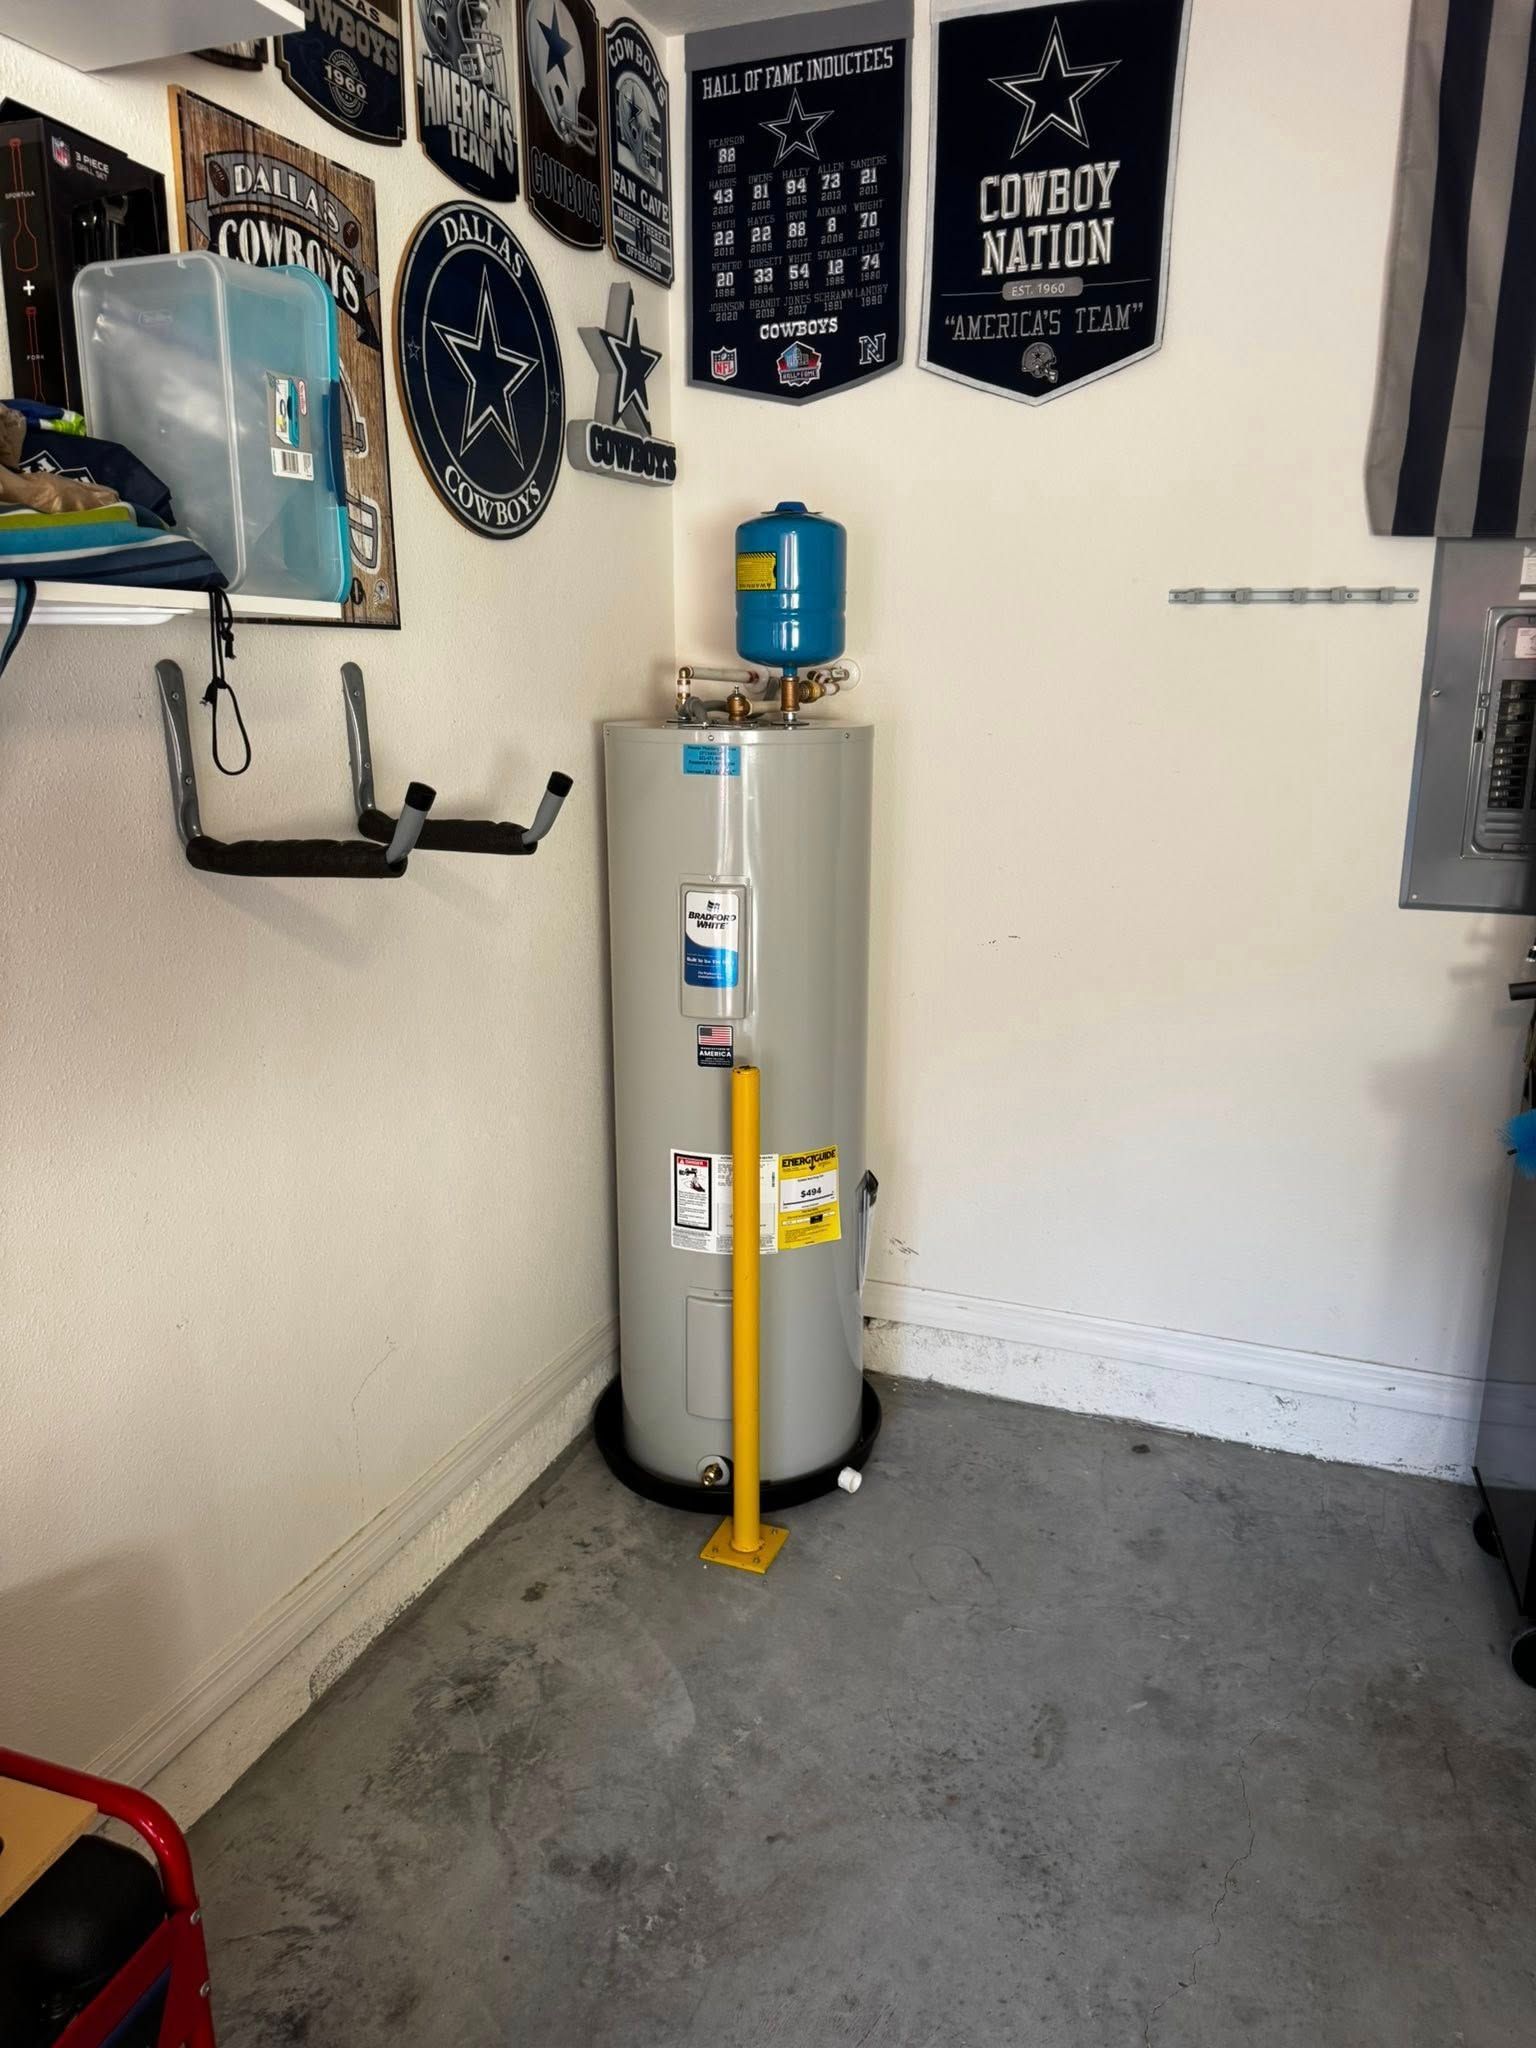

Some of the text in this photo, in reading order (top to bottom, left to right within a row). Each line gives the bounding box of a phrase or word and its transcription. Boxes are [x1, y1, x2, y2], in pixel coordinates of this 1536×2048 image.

[299, 0, 399, 77] OWBOYS
[324, 63, 368, 101] 1960
[607, 36, 666, 108] COWBOYS
[702, 46, 893, 100] HALL OF FAME INDUCTEES
[422, 56, 515, 176] AMERICA'S
[75, 151, 110, 174] 3 PIECE
[447, 122, 496, 180] TEAM
[719, 147, 736, 163] 88
[530, 145, 602, 229] COWBOYS
[713, 167, 877, 204] 43 81 94 73 21
[782, 167, 810, 180] HALEY
[817, 162, 844, 174] ALLEN
[233, 162, 341, 233] DALLAS
[613, 168, 670, 225] FAN CAVE
[979, 160, 1121, 223] COWBOY
[617, 204, 641, 229] WHERE
[711, 219, 736, 231] SMITH
[747, 214, 776, 226] HAYES
[712, 204, 735, 216] 2020
[440, 213, 524, 279] DALLAS
[714, 211, 878, 247] 22 22 88 8 70
[981, 217, 1115, 276] NATION
[218, 217, 361, 314] COWBOYS
[716, 253, 881, 288] 20 33 54 12 74
[788, 252, 813, 264] WHITE
[708, 301, 745, 313] JOHNSON
[749, 297, 781, 310] BRANDT
[784, 293, 812, 307] JONES
[855, 283, 889, 297] LANDRY
[1011, 282, 1066, 297] EST. 1960
[715, 311, 738, 322] 2020
[755, 307, 775, 319] 2019
[788, 304, 808, 316] 2017
[759, 317, 839, 340] COWBOYS
[945, 302, 1144, 341] “AMERICA’S TEAM”
[714, 360, 734, 374] NFL
[588, 424, 677, 481] COWBOYS
[445, 465, 541, 526] COWBOYS
[688, 911, 737, 923] BRADFORD
[696, 920, 726, 930] WHITE
[699, 1050, 732, 1058] AMERICA
[800, 1187, 822, 1198] $494
